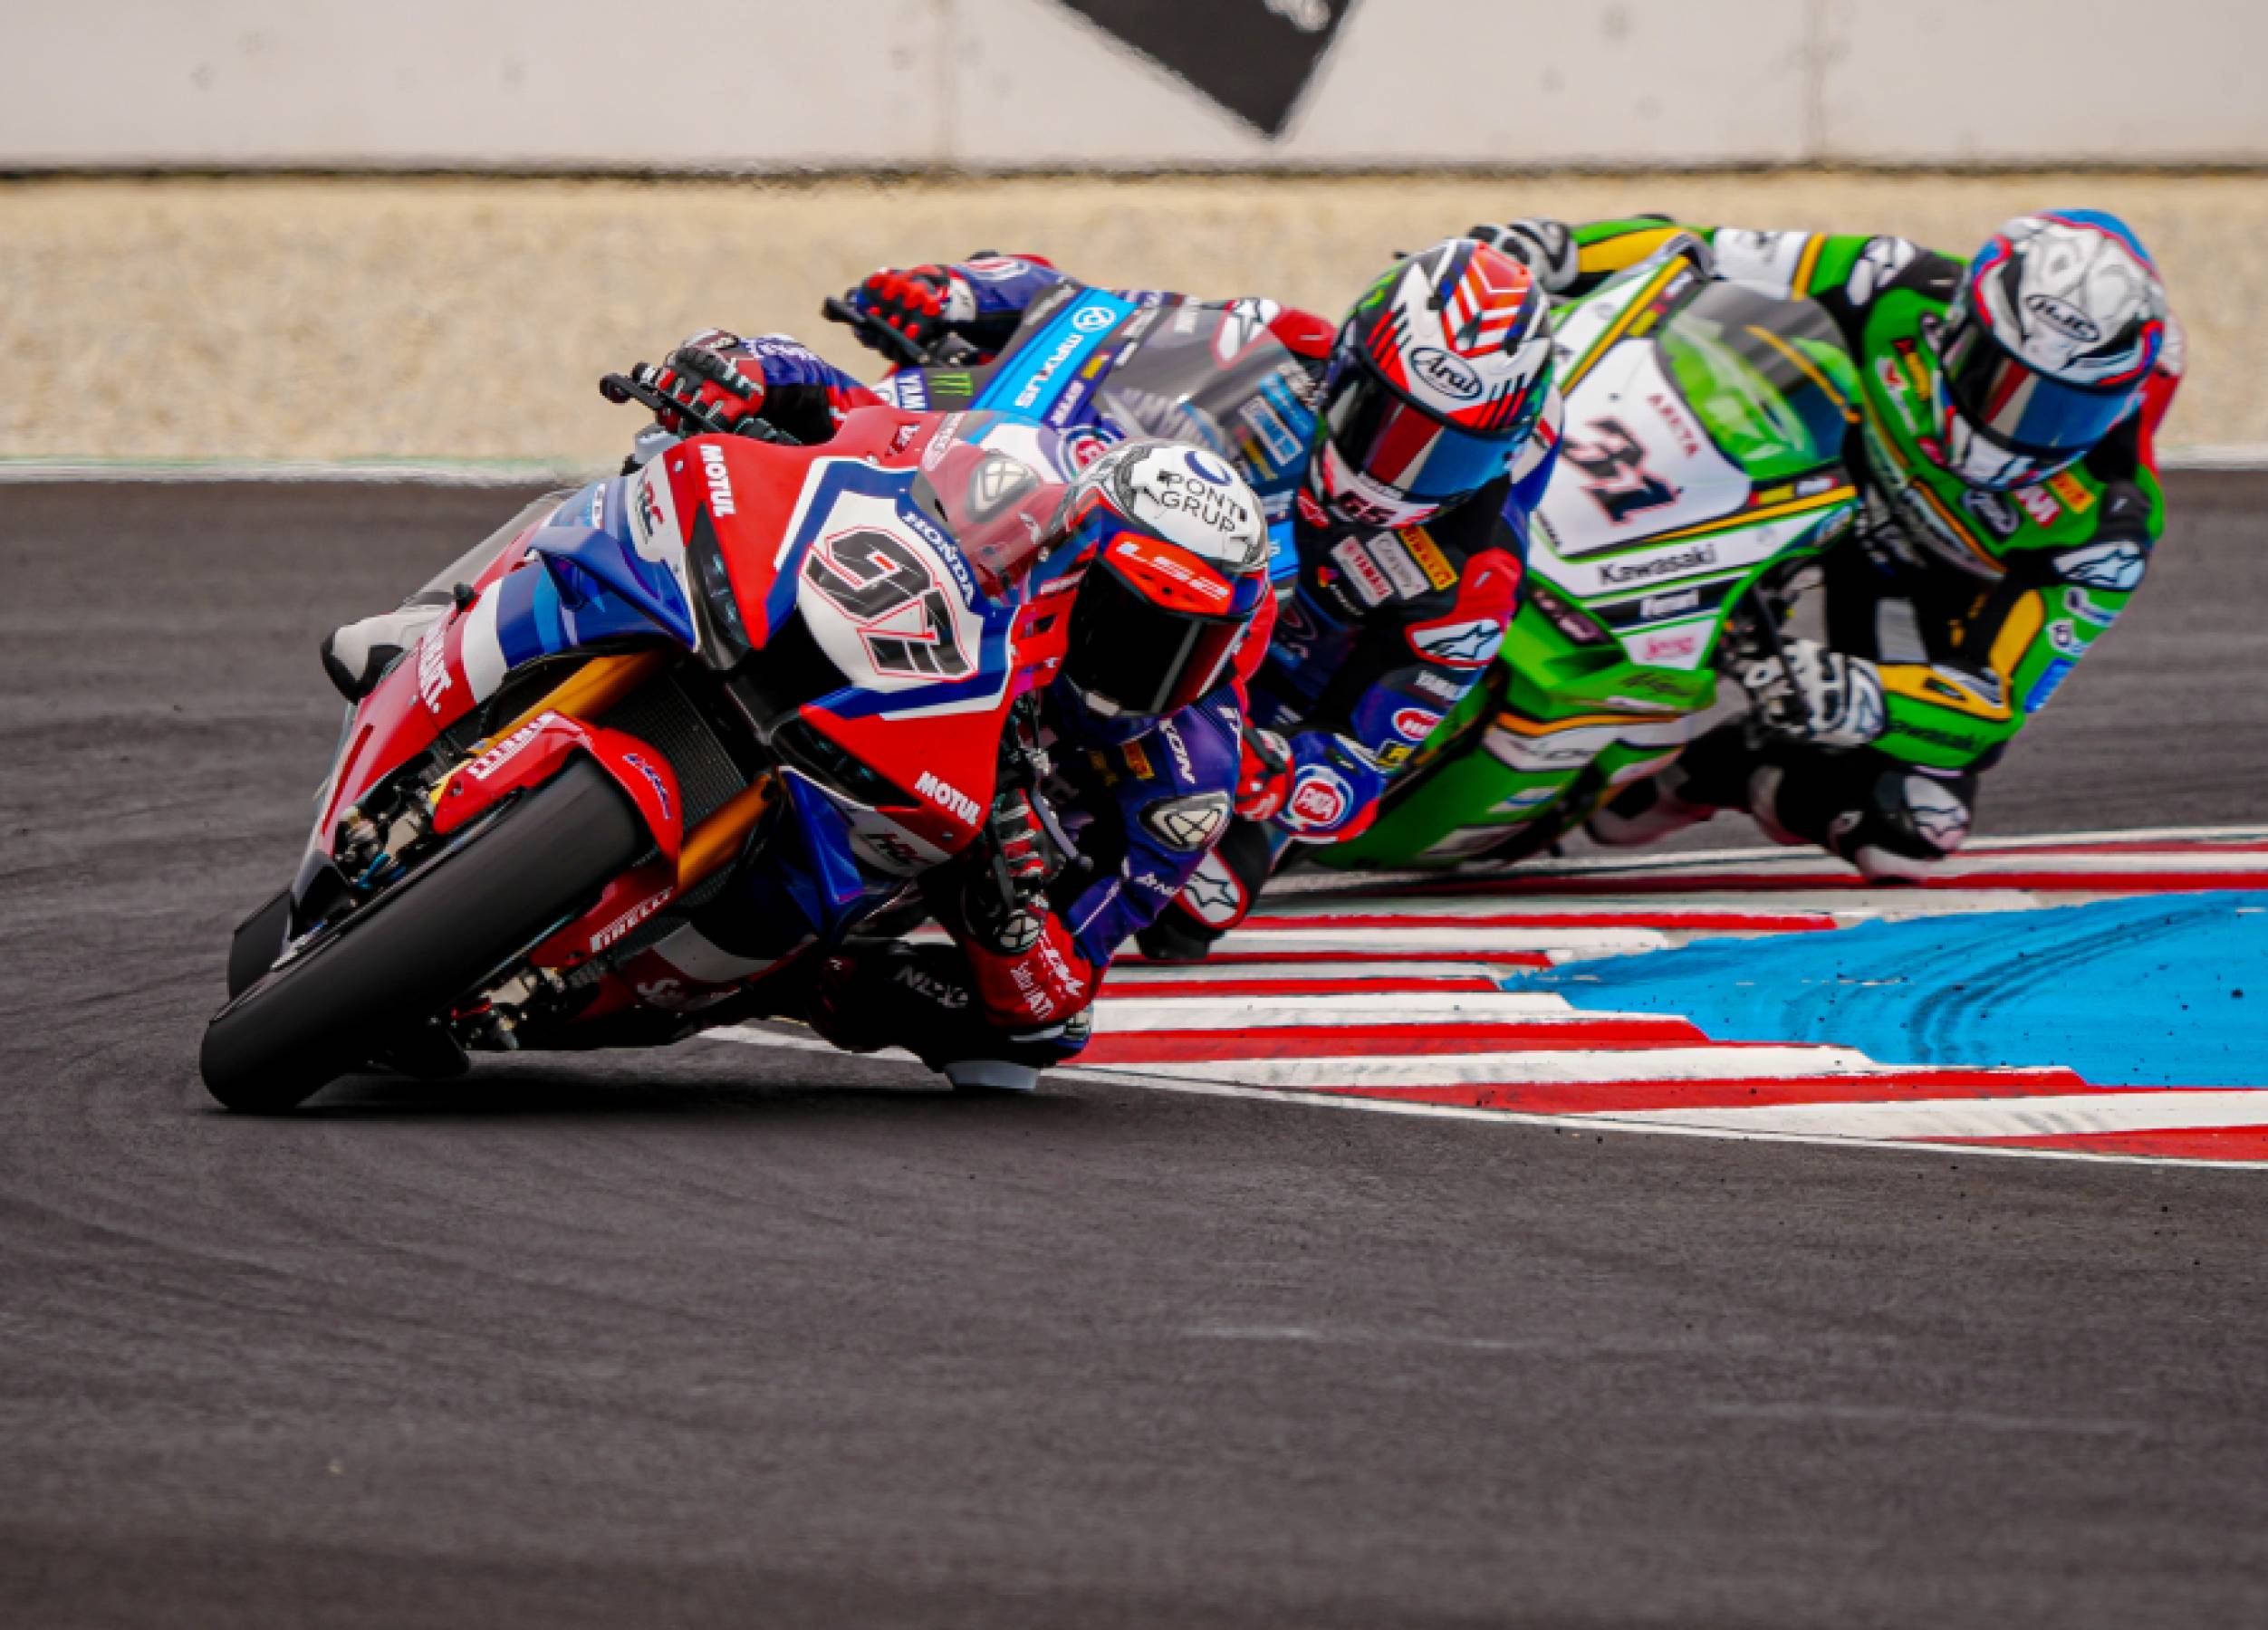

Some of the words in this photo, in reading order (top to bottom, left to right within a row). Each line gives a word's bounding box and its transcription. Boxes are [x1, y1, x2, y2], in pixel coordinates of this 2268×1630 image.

[2033, 298, 2097, 336] HJC
[896, 372, 927, 412] YAM
[1428, 354, 1476, 392] Arai
[700, 445, 736, 518] MOTUL
[1165, 472, 1242, 517] PONT
[1560, 417, 1683, 525] 31
[1160, 490, 1236, 532] GRUP
[902, 511, 975, 607] HONDA
[1115, 542, 1229, 600] LS2
[1598, 543, 1717, 585] Kawasaki
[798, 525, 979, 684] 97
[465, 711, 560, 781] PIRELLI
[914, 770, 981, 827] MOTUL
[1295, 785, 1340, 821] PATA
[588, 885, 674, 954] PIRELLI
